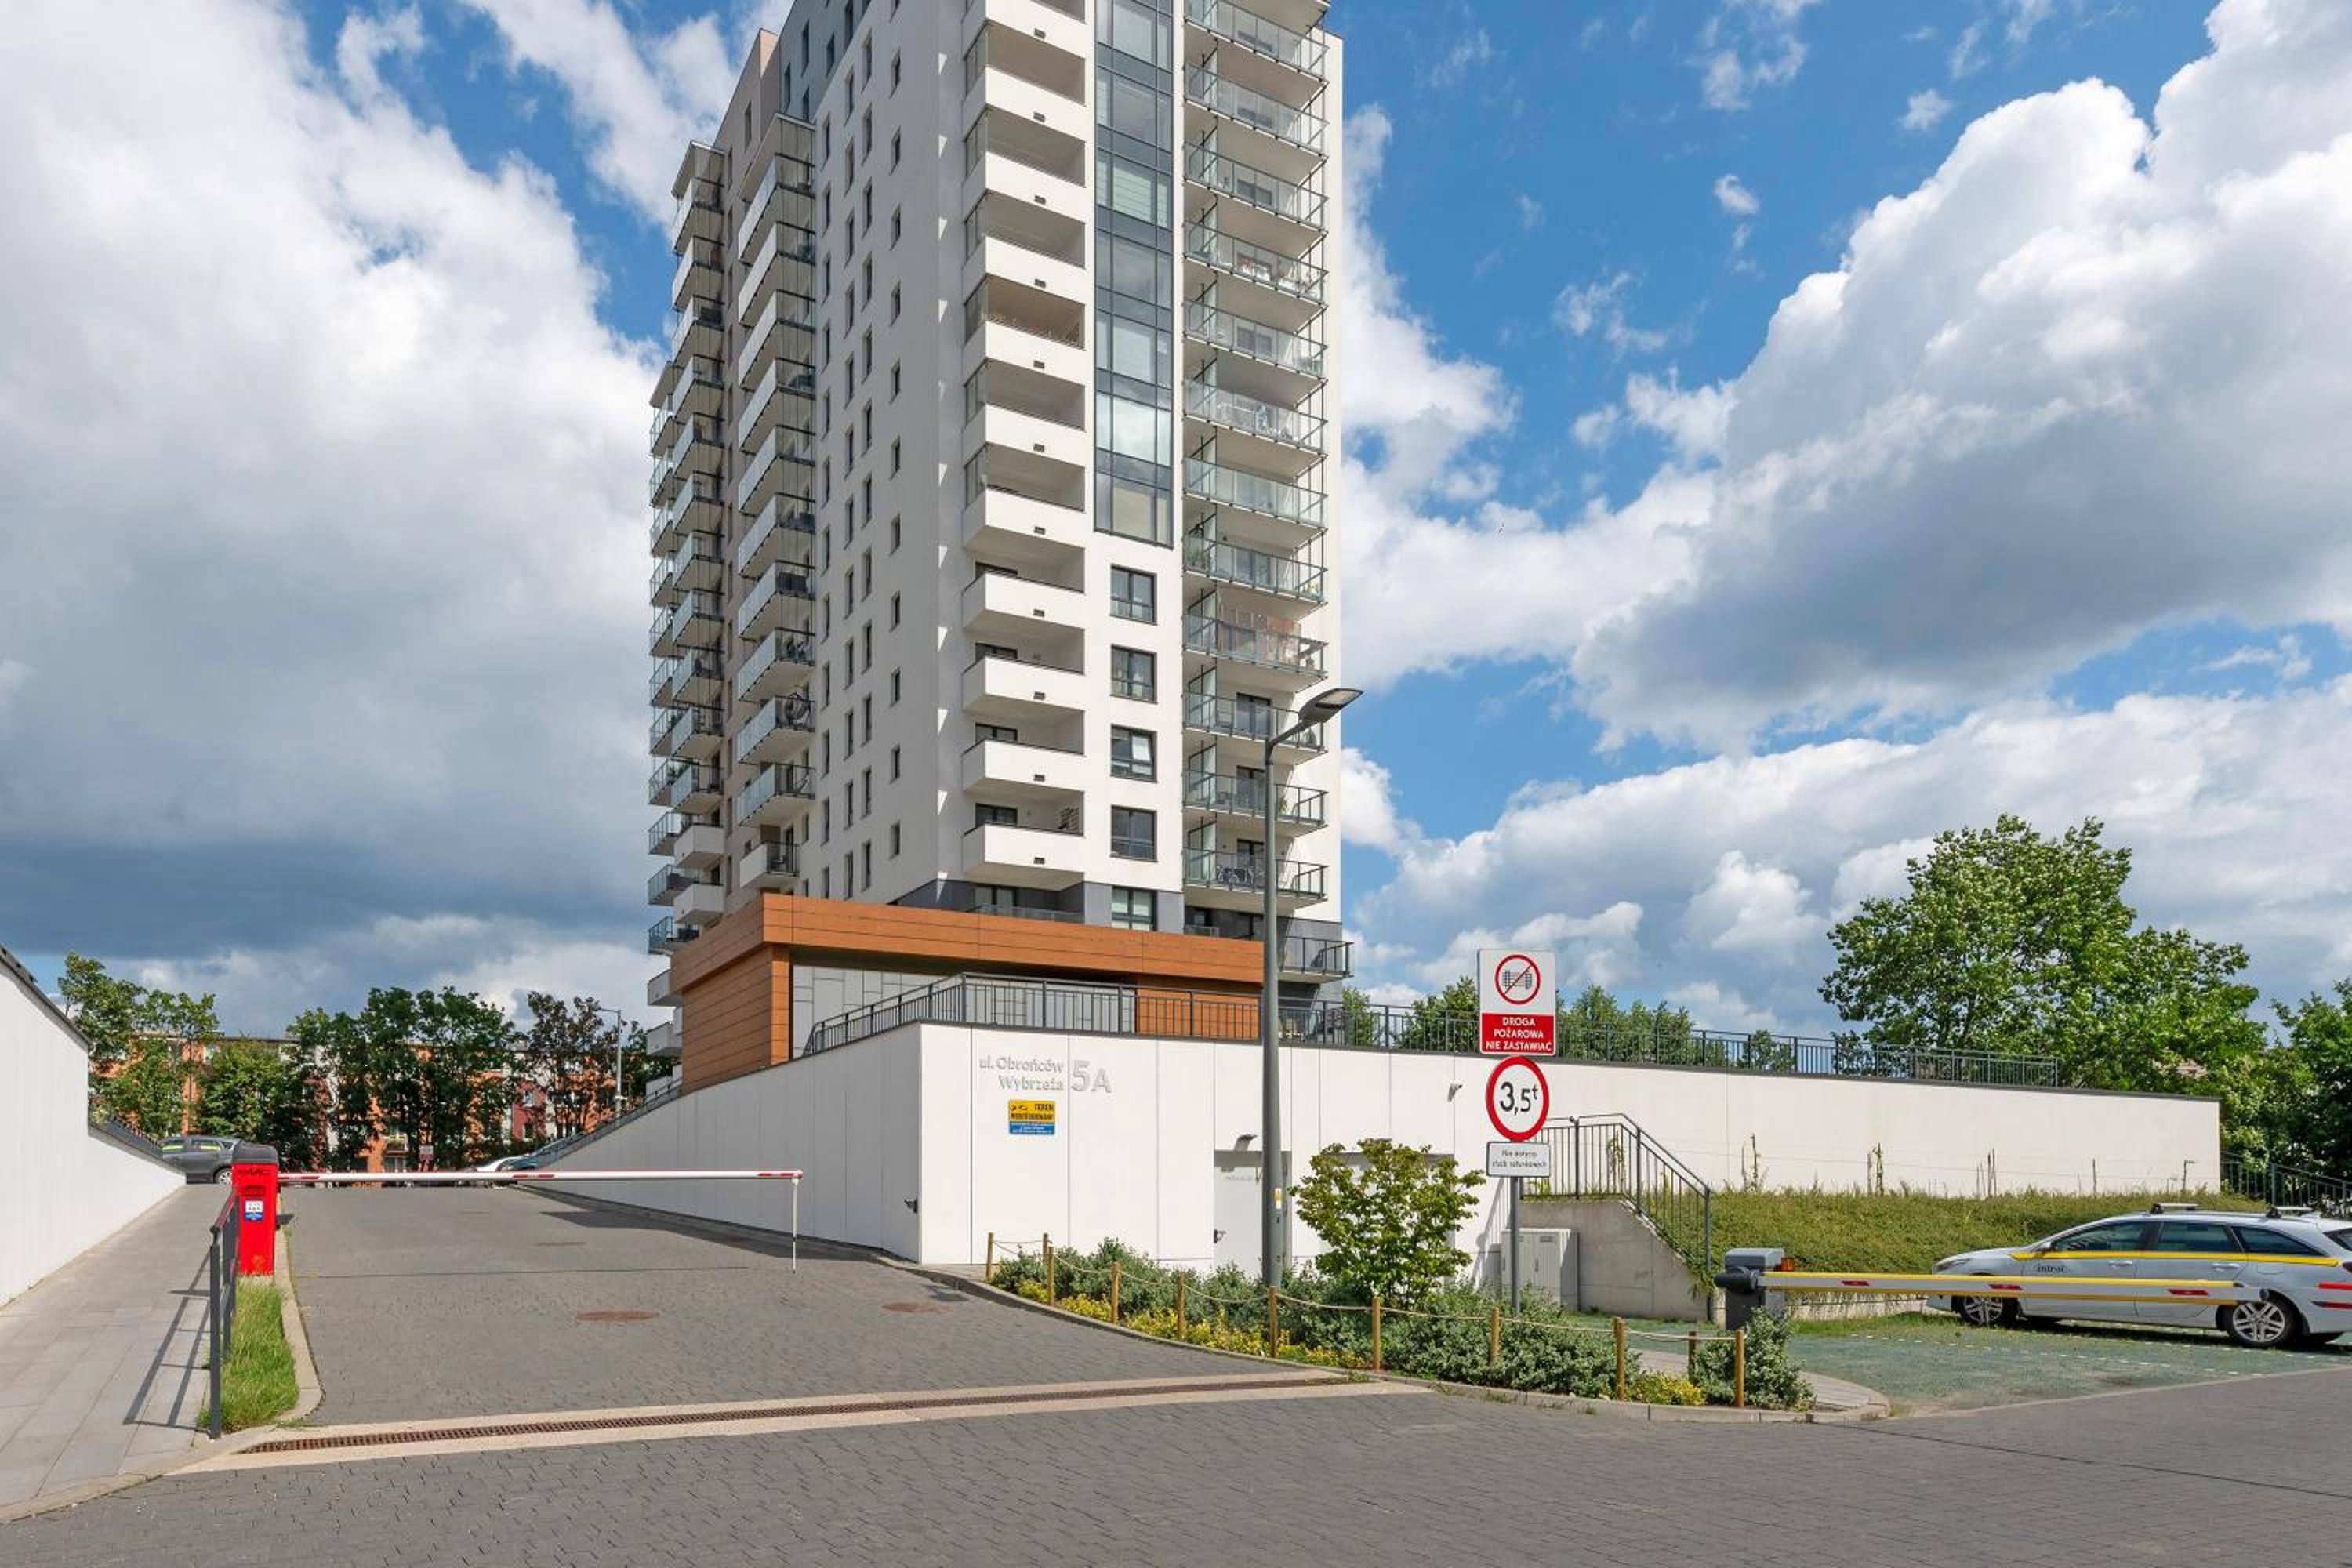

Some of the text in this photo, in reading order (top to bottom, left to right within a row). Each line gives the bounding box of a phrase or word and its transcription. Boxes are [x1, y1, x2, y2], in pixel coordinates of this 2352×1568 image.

[1502, 1017, 1535, 1026] DROGA
[1494, 1028, 1544, 1038] POŻAROWA
[1486, 1040, 1552, 1051] NIE ZASTAWIAĆ
[979, 1054, 1064, 1073] ul. Obrońców
[999, 1075, 1064, 1092] Wybrzeża
[1071, 1060, 1112, 1093] 5A
